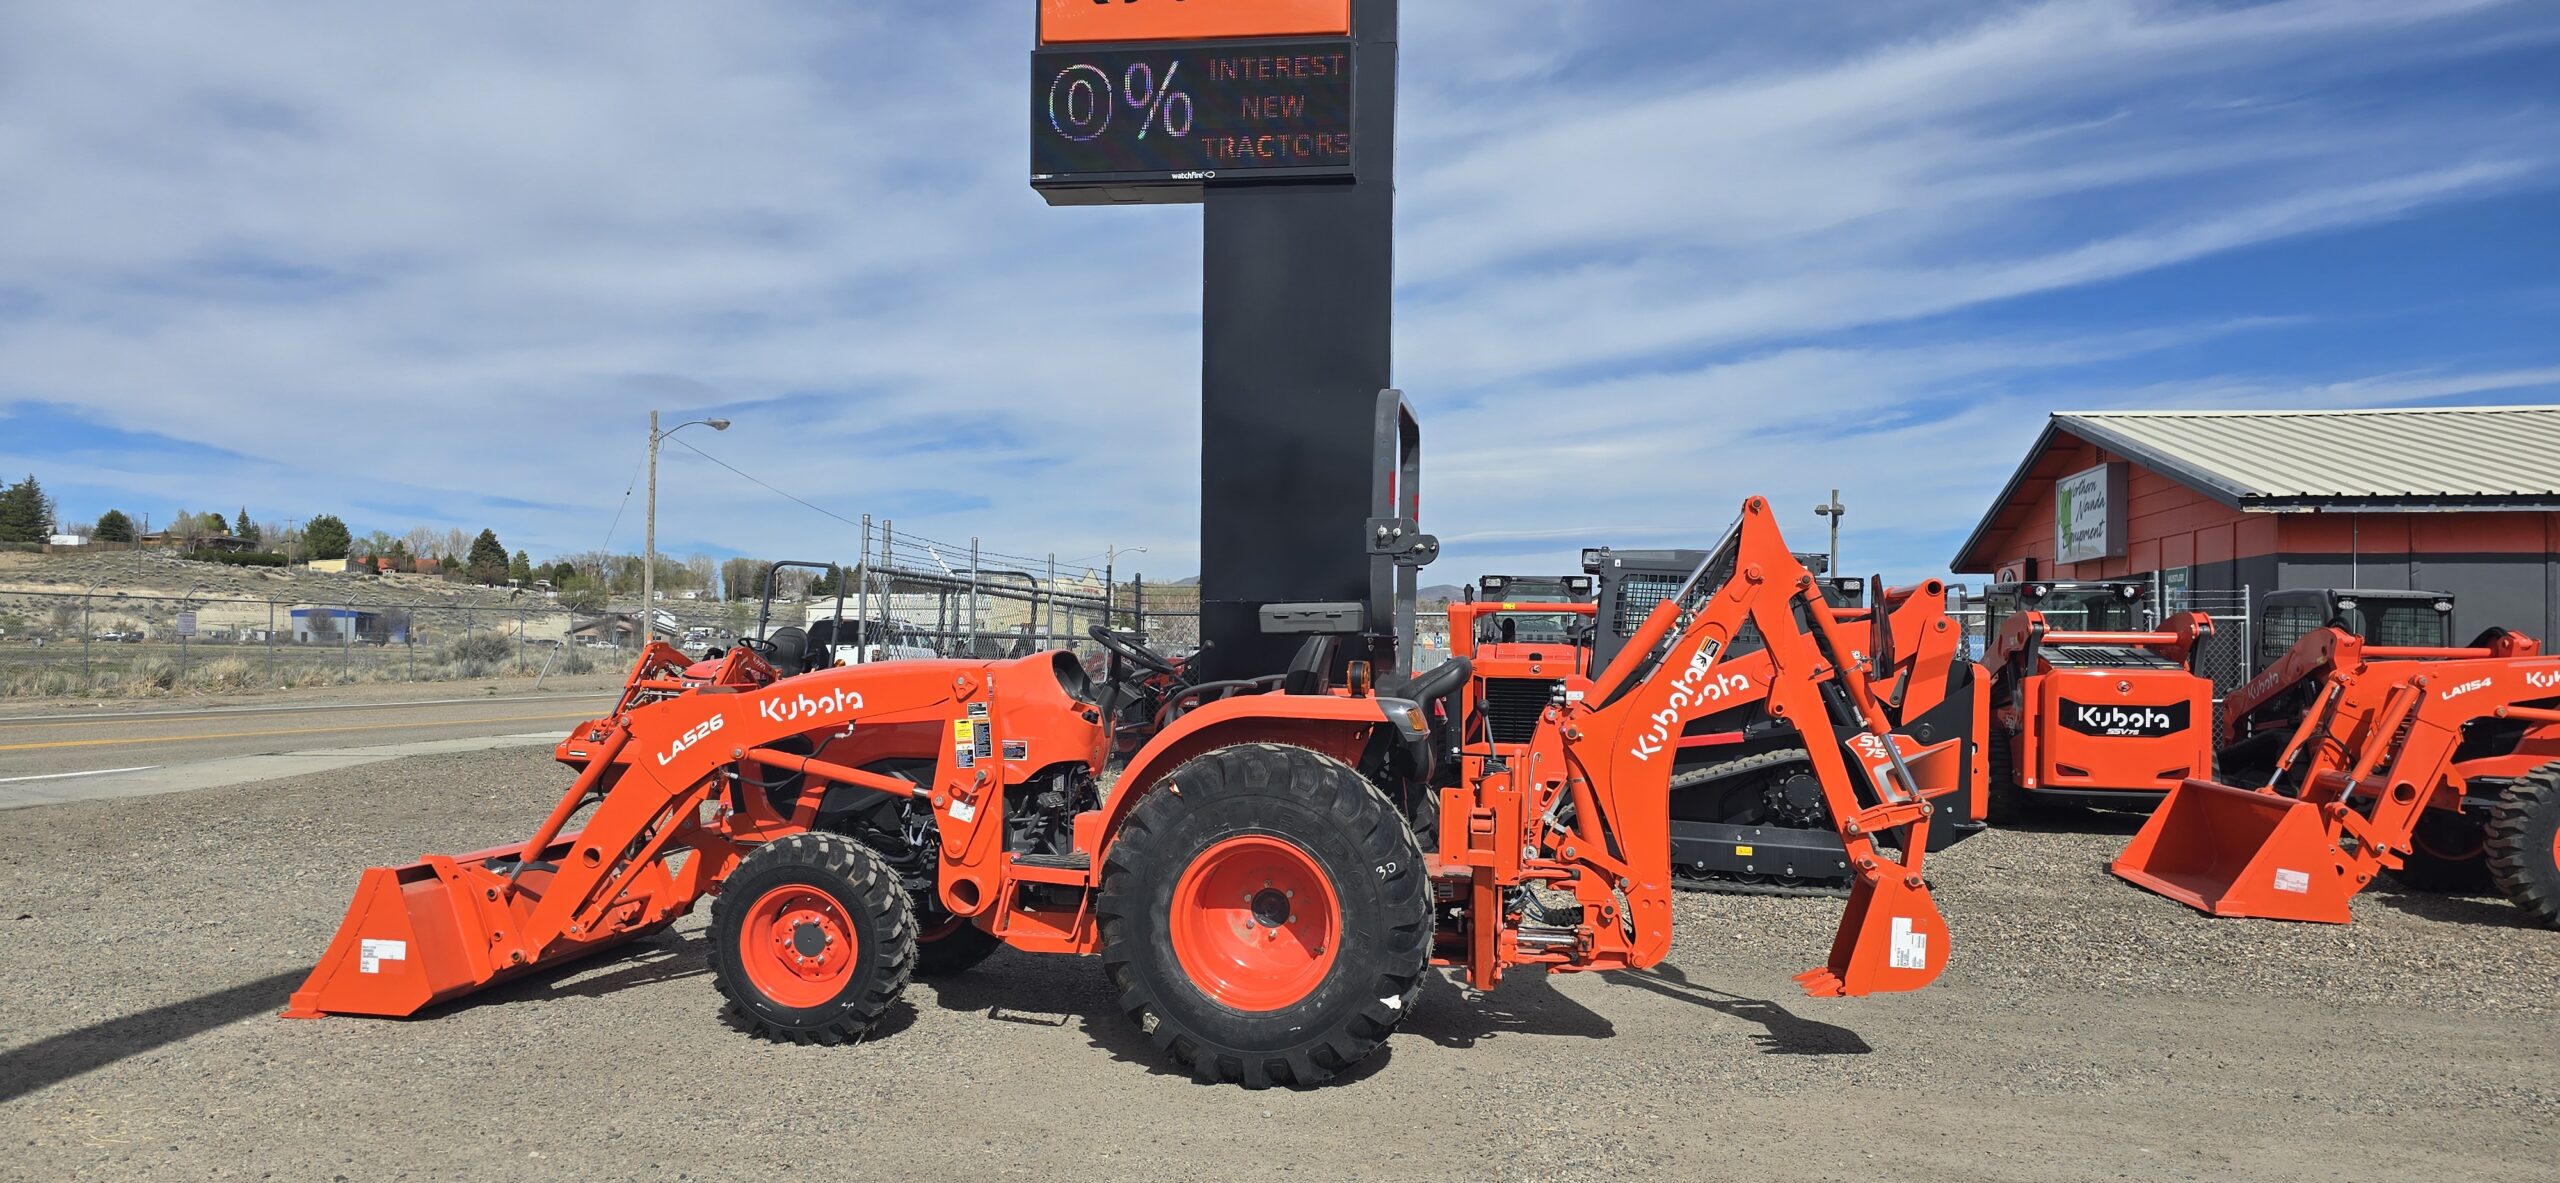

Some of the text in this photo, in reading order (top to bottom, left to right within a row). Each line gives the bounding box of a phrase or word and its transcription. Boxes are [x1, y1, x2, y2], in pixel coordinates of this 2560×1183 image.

[1209, 53, 1345, 81] INTEREST
[1241, 95, 1305, 120] NEW
[1201, 133, 1350, 160] TRACTORS
[1171, 171, 1205, 180] watchfire
[2247, 671, 2279, 700] Kubota
[2441, 677, 2492, 701] LA1154
[759, 687, 864, 722] Kubota
[1630, 667, 1705, 761] Kubota
[2078, 706, 2170, 729] Kubota
[656, 713, 724, 766] LA526
[2105, 727, 2140, 736] SSV75
